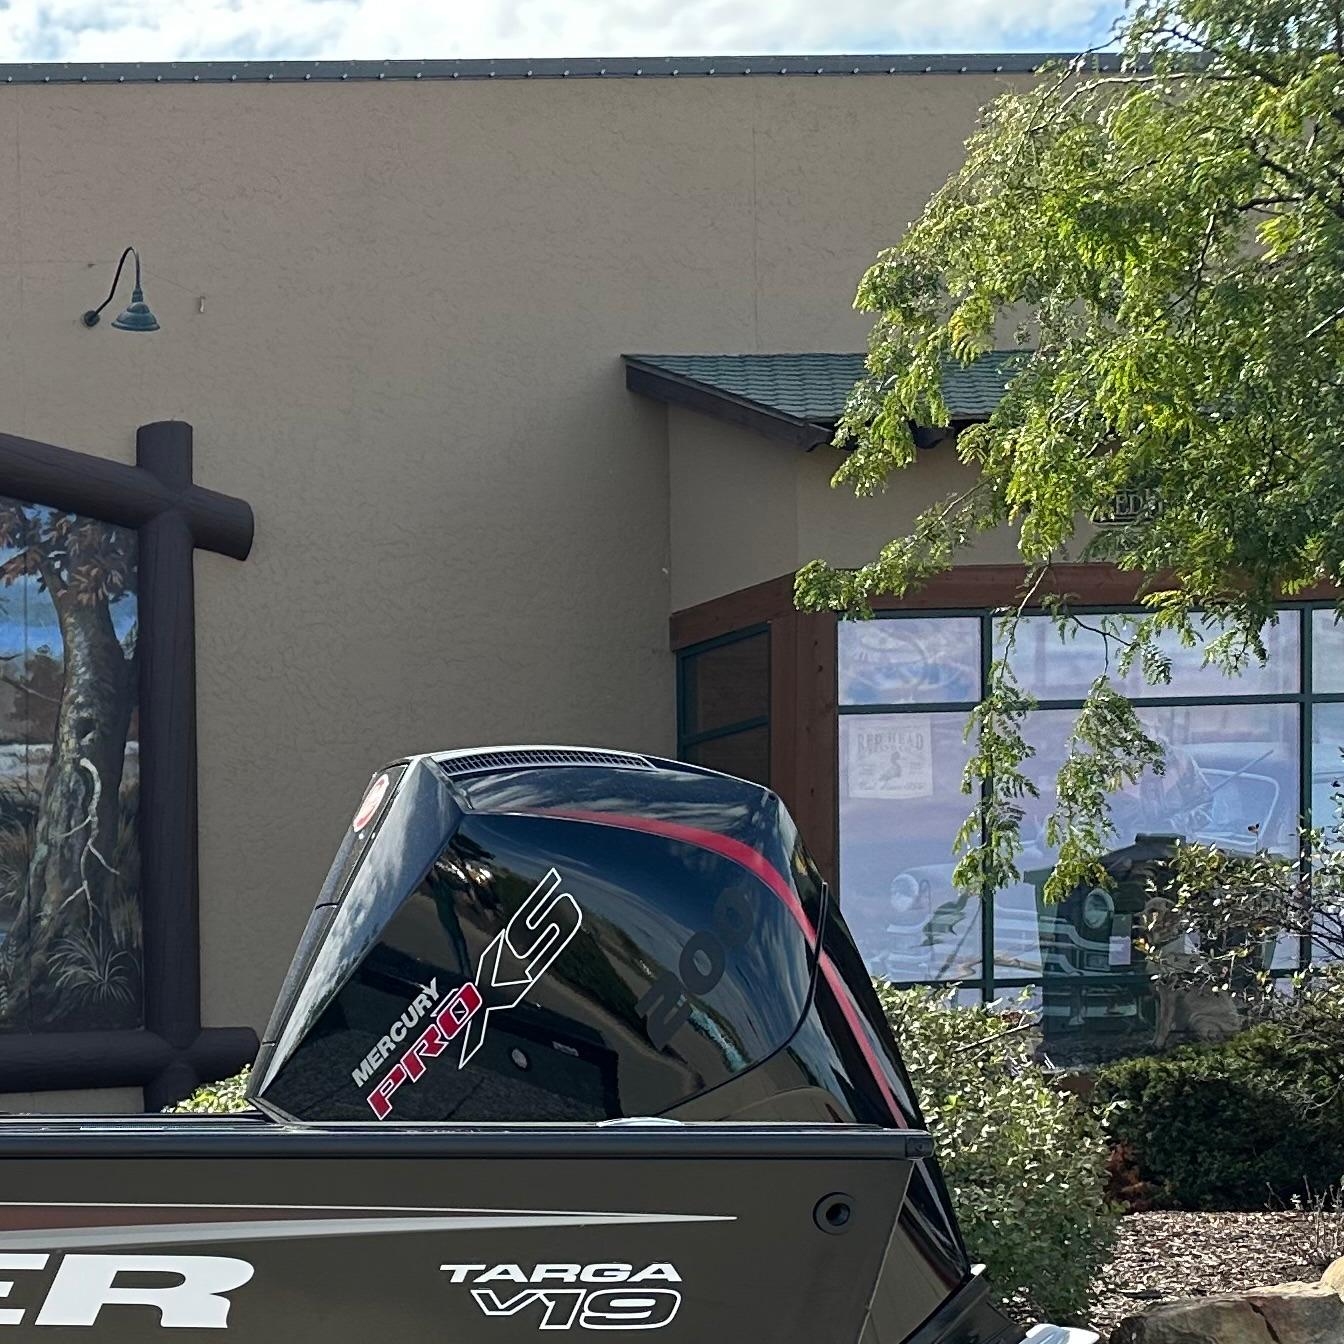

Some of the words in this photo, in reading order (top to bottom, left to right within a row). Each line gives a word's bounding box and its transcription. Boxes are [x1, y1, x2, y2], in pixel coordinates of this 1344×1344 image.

[351, 977, 439, 1087] MERCURY
[367, 981, 483, 1121] PRO
[430, 867, 582, 1069] XS
[439, 1262, 683, 1283] TARGA
[470, 1287, 682, 1330] V19
